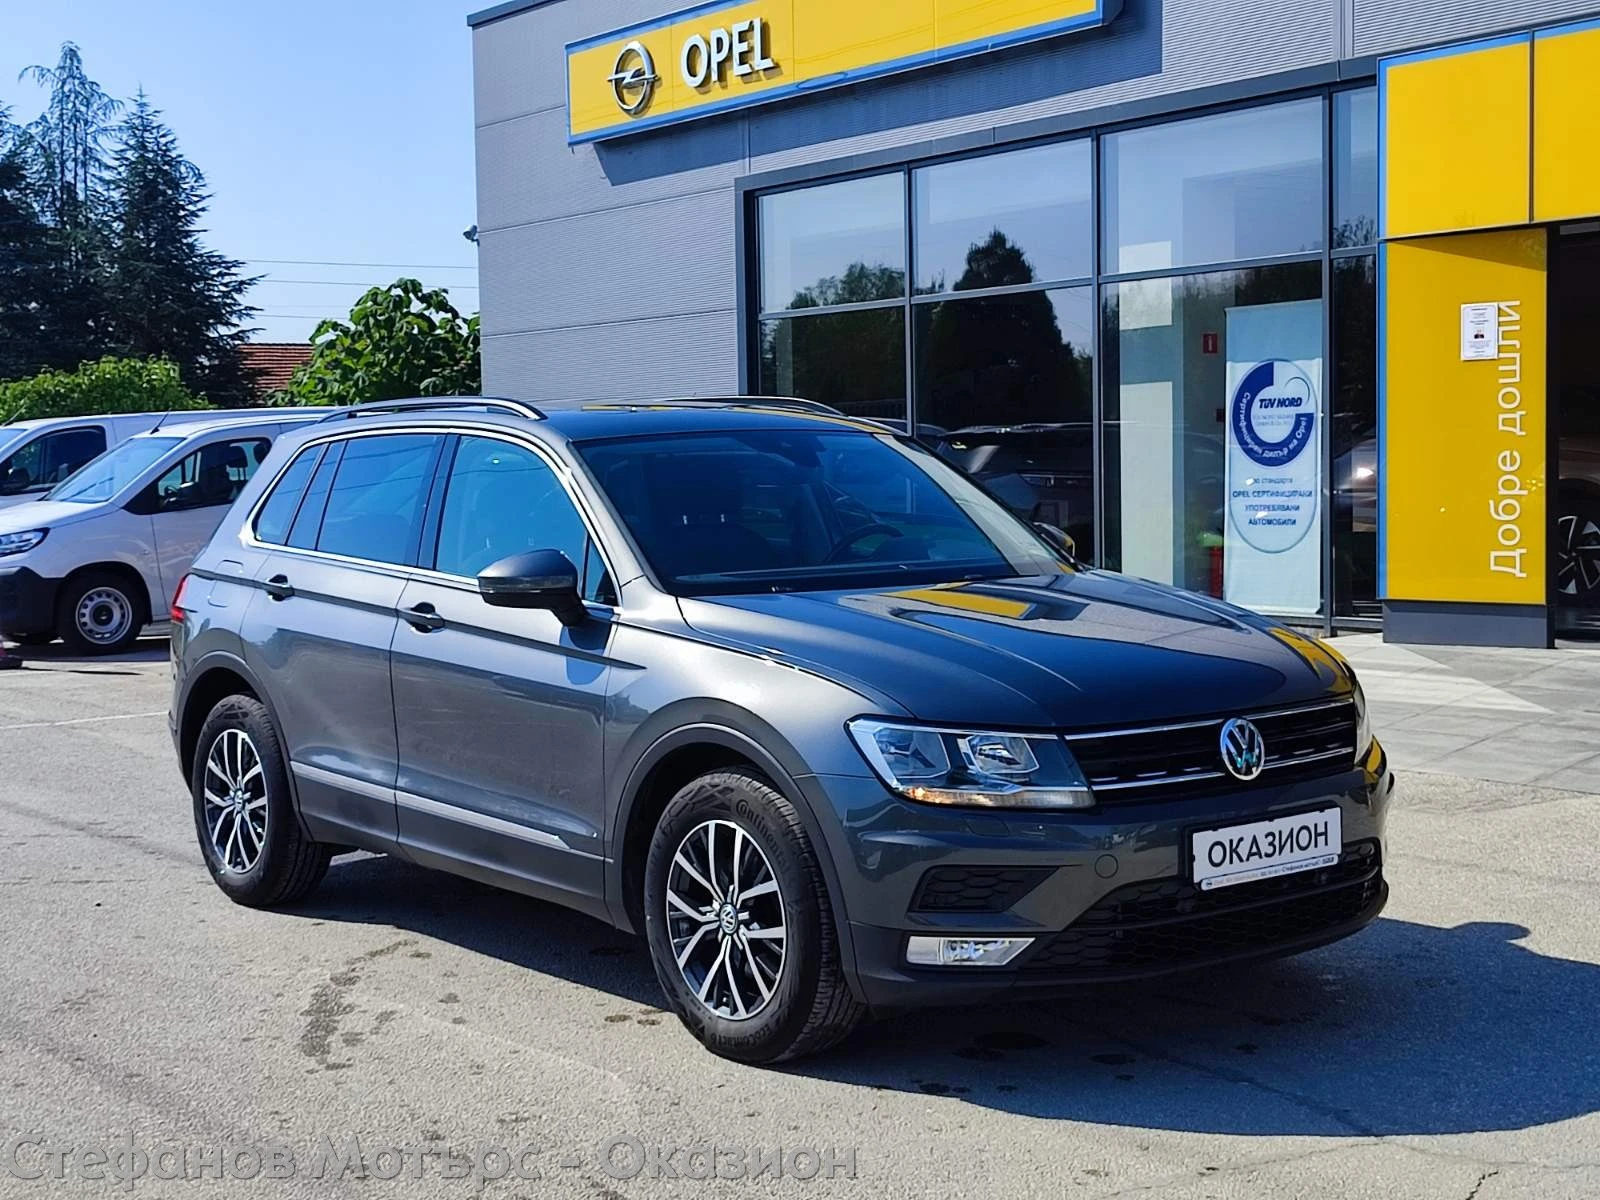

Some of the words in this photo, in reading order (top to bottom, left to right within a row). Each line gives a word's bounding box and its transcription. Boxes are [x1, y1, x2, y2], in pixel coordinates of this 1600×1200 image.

[680, 17, 775, 88] OPEL
[1497, 300, 1526, 436] дошли
[1276, 397, 1303, 408] NORD
[1295, 417, 1308, 439] Opel
[1232, 490, 1250, 498] OPEL
[1489, 449, 1528, 578] Добре
[1208, 820, 1329, 868] ОКАЗИОН
